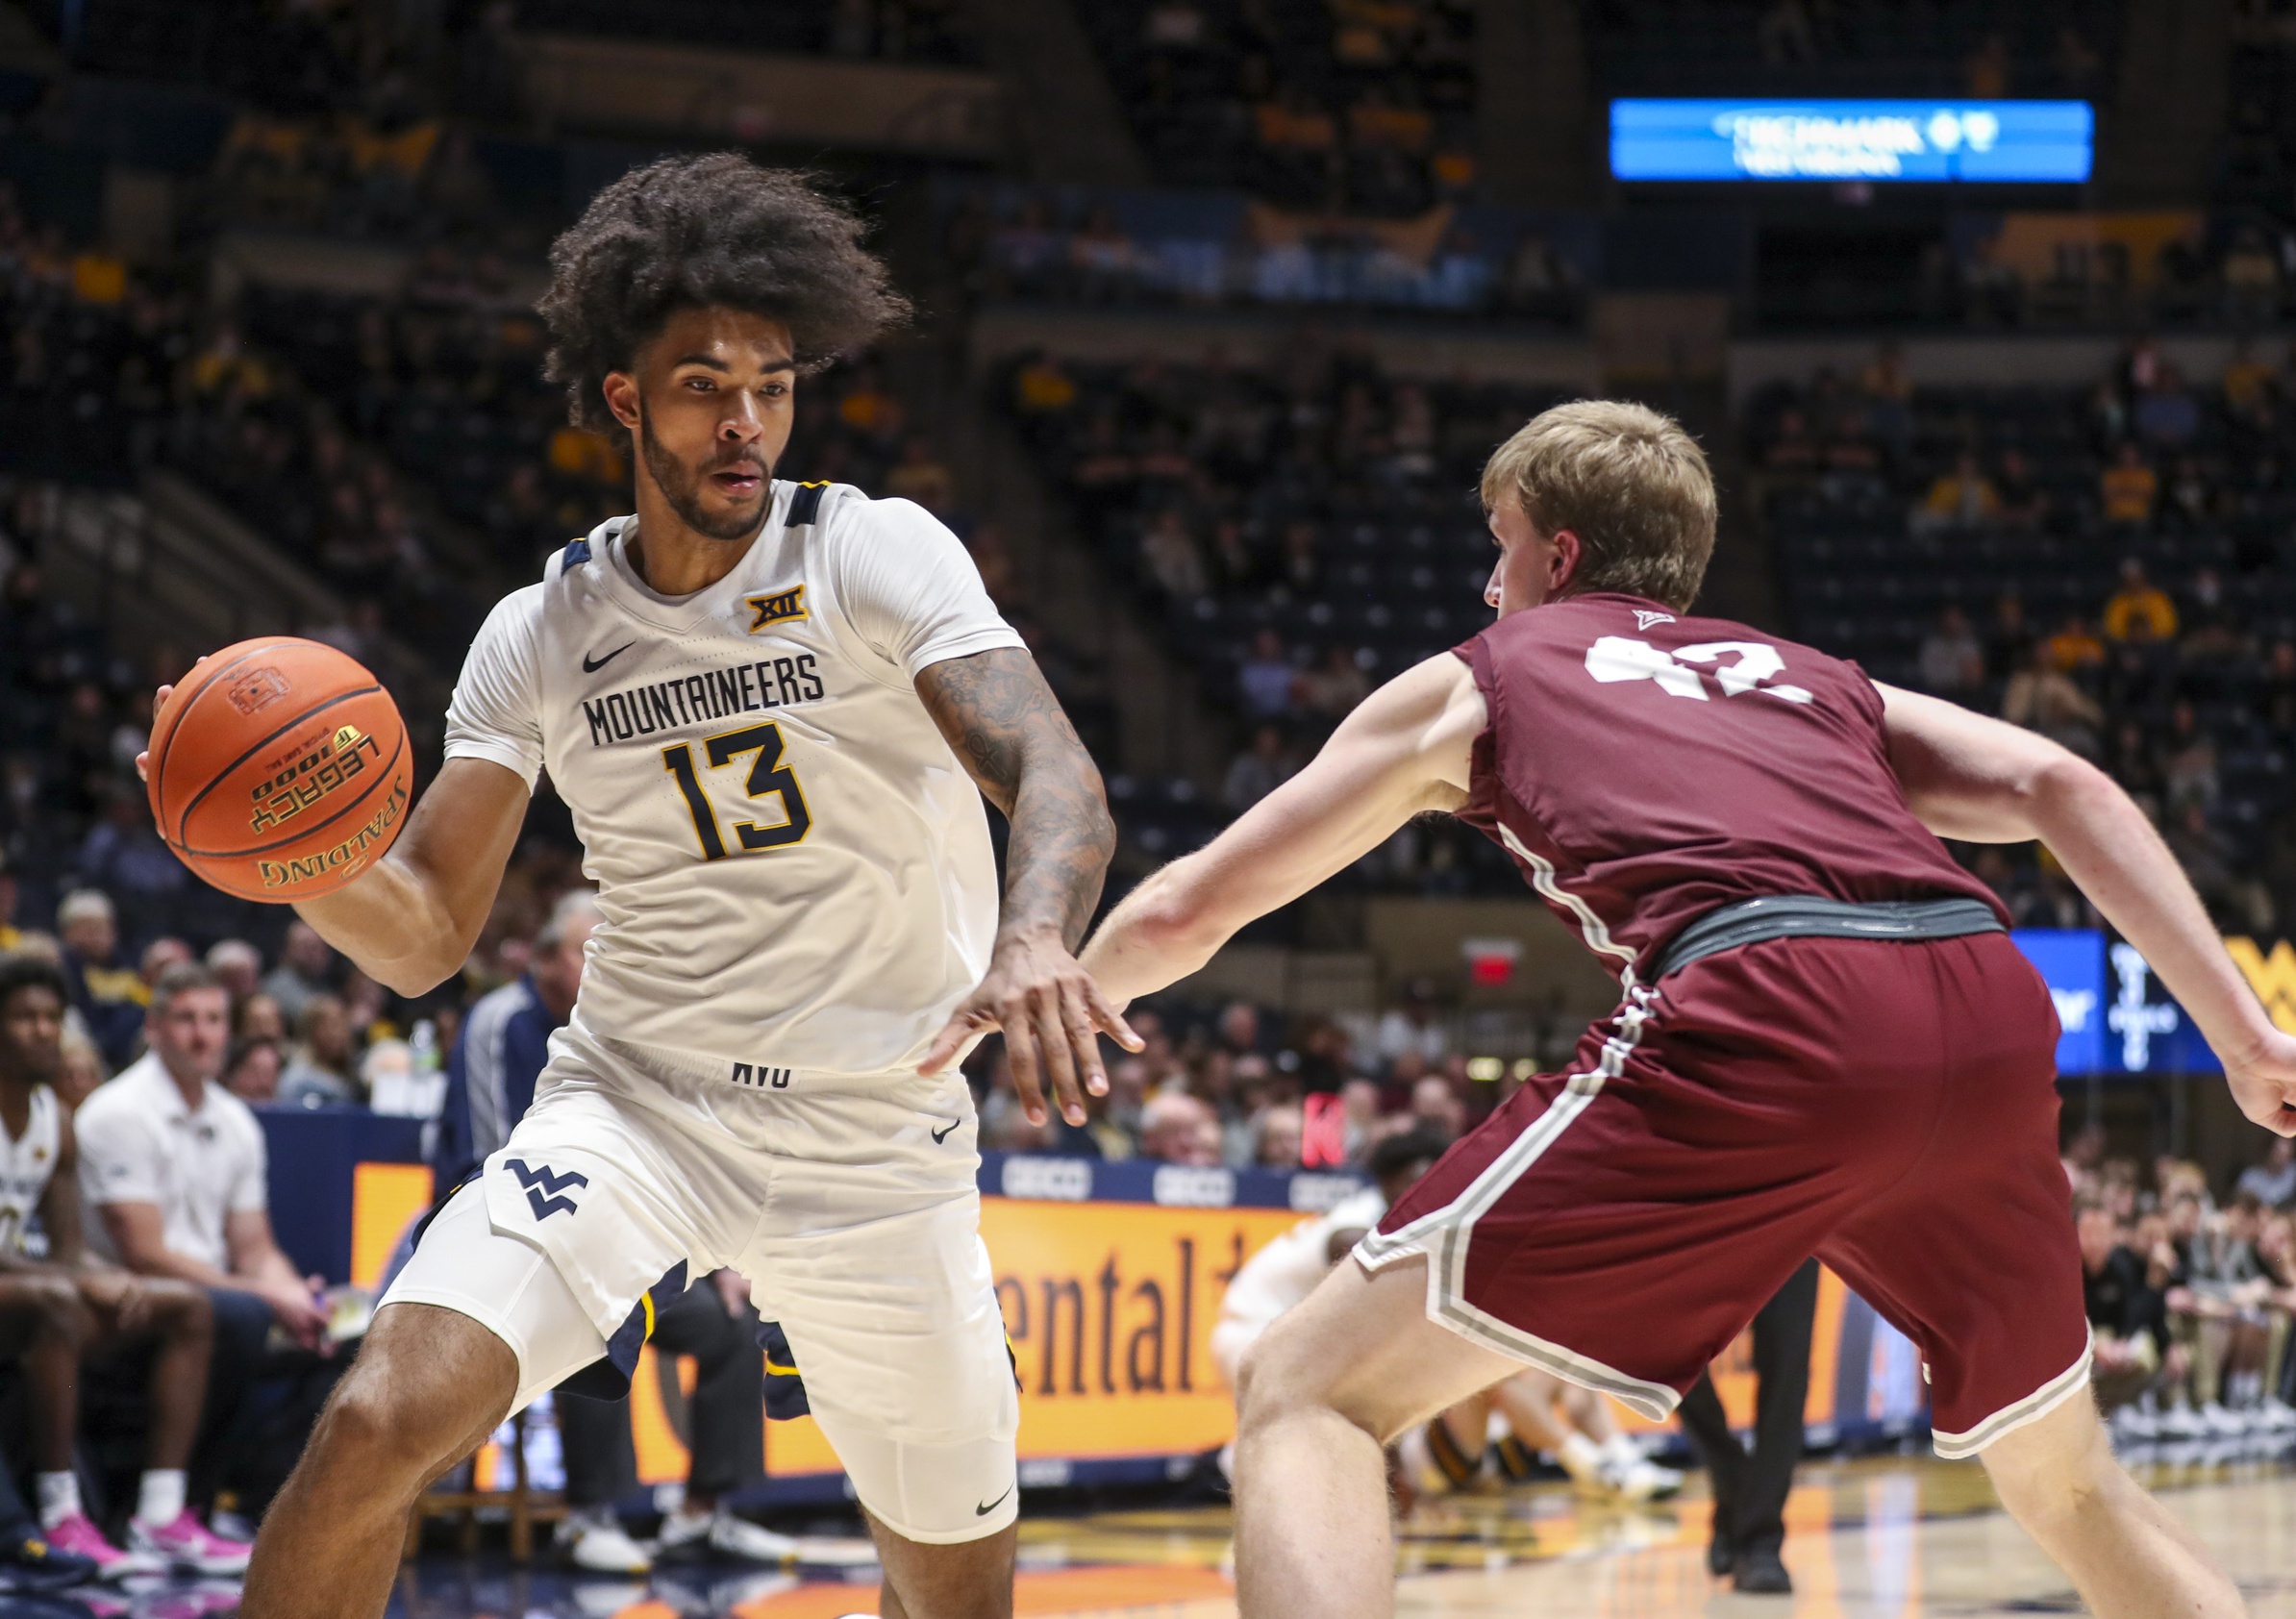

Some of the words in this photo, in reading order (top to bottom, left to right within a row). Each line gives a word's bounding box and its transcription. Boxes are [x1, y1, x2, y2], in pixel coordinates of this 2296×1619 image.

[749, 588, 806, 630] XII
[582, 654, 825, 747] MOUNTAINEERS
[249, 733, 383, 835] LEGACY
[251, 743, 335, 803] 1000
[661, 720, 814, 861] 13
[259, 773, 408, 889] SPALDING
